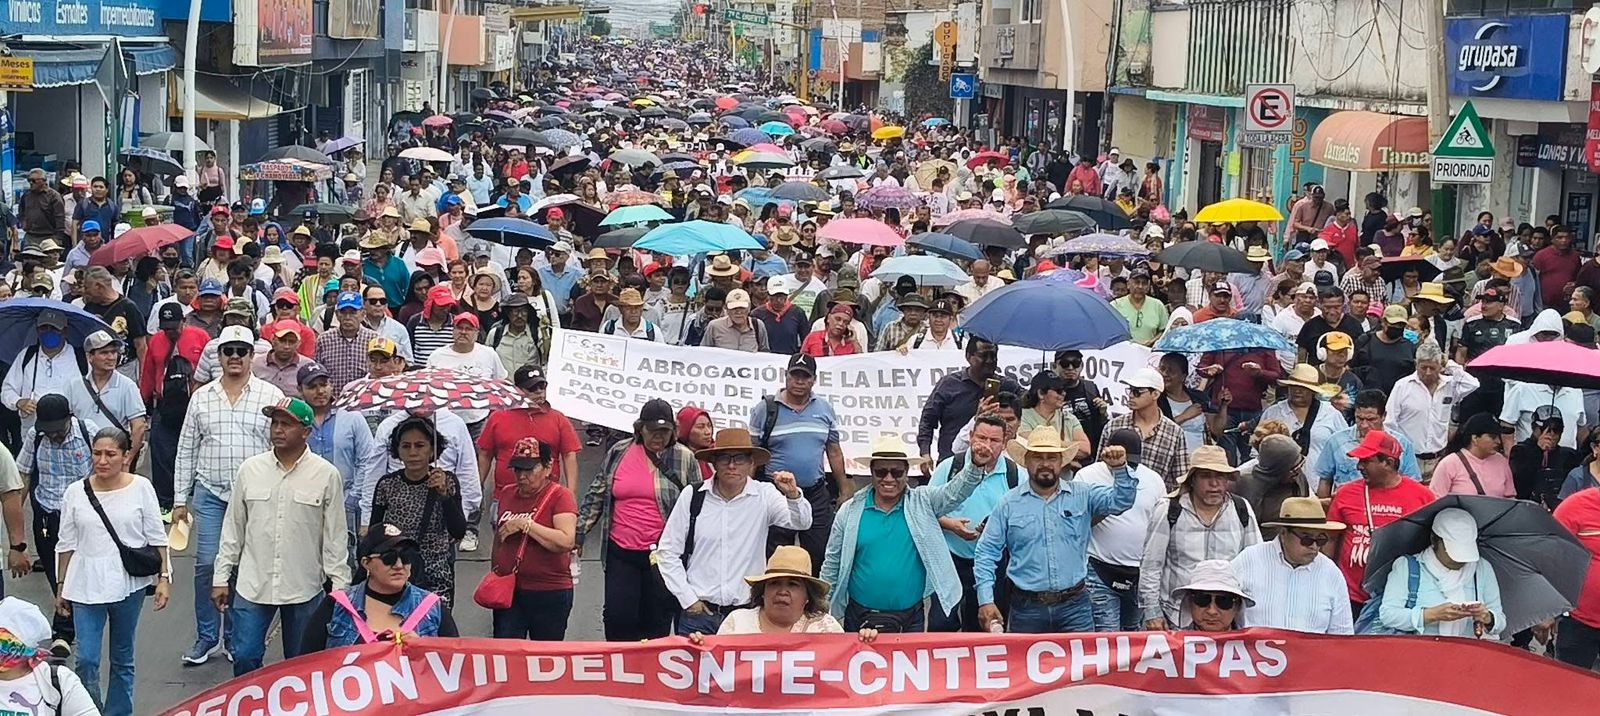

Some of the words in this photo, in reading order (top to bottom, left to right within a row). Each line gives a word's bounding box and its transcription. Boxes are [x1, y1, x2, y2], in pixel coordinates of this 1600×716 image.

[1, 59, 30, 68] Meses
[1458, 45, 1519, 72] grupasa
[1246, 133, 1261, 143] TODA
[1262, 133, 1270, 143] LA
[1270, 133, 1290, 144] ACERA
[1323, 137, 1361, 164] Tamales
[1286, 117, 1308, 214] OPTIC
[1377, 146, 1430, 165] Tama
[1537, 143, 1568, 161] LONAS
[1569, 146, 1577, 162] Y
[1436, 162, 1491, 178] PRIORIDAD
[561, 361, 716, 397] ABROGACIÓN
[724, 384, 753, 400] DE
[637, 357, 786, 384] ABROGACIÓ
[841, 370, 871, 388] LA
[877, 368, 922, 388] LEY
[1083, 355, 1125, 383] 007
[558, 386, 639, 414] PAGO
[569, 378, 626, 400] PAGO
[671, 398, 756, 417] SALARI
[889, 415, 903, 428] Y
[1370, 504, 1403, 514] HIAPAS
[174, 650, 420, 716] ECCIÓN
[424, 650, 508, 693] VII
[526, 652, 645, 685] DEL
[657, 644, 1011, 697] SNTE-CNTE
[1025, 634, 1288, 685] CHIAPAS
